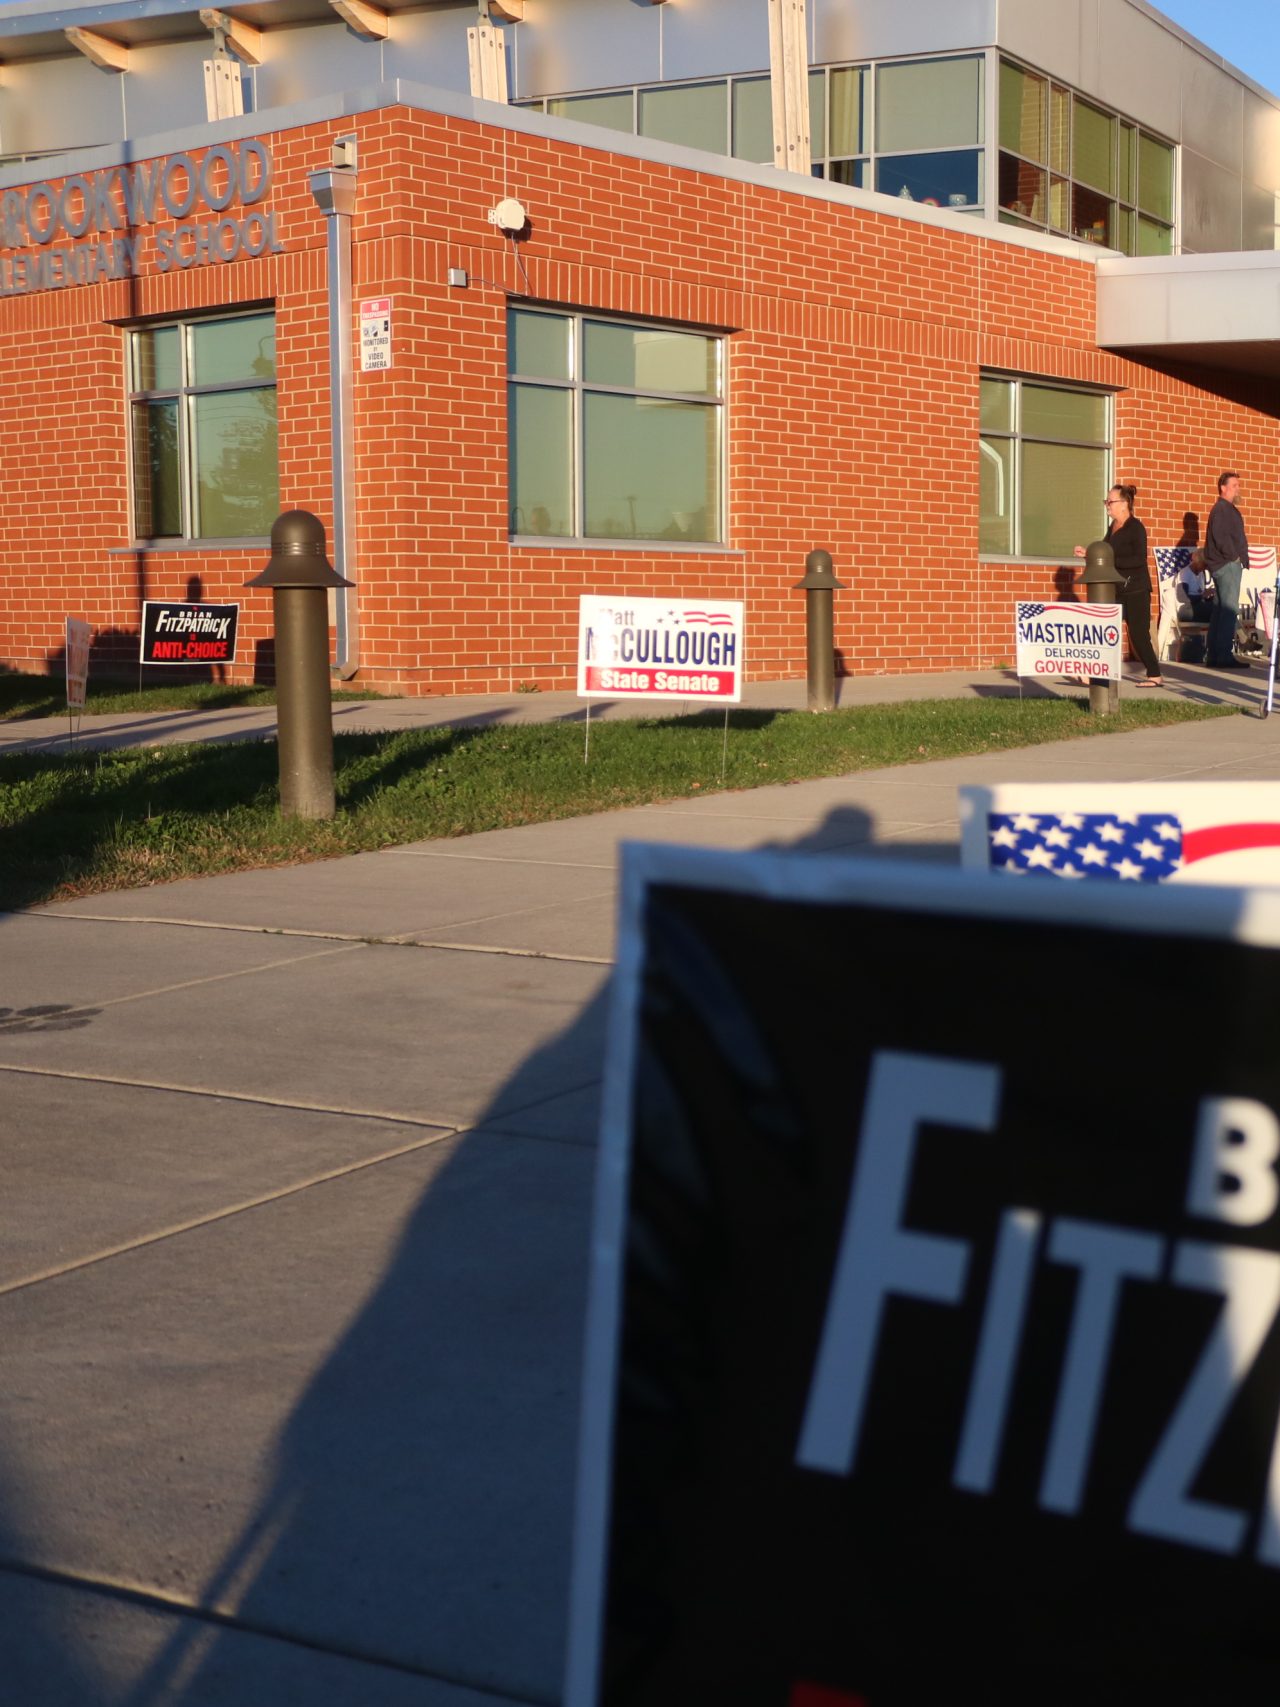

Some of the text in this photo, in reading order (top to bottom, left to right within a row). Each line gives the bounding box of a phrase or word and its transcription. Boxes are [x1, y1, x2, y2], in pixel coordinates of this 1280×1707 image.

[156, 211, 284, 272] SCHOOL
[363, 338, 389, 347] MONITORED
[364, 360, 388, 369] CAMERA
[368, 352, 384, 361] VIDEO
[155, 610, 231, 639] FITZPATRICK
[600, 609, 635, 626] att
[1019, 623, 1119, 646] MASTRIANO
[152, 641, 228, 658] ANTI-CHOICE
[1045, 648, 1100, 660] DELROSSO
[1034, 660, 1109, 676] GOVERNOR
[600, 669, 720, 692] State Senate
